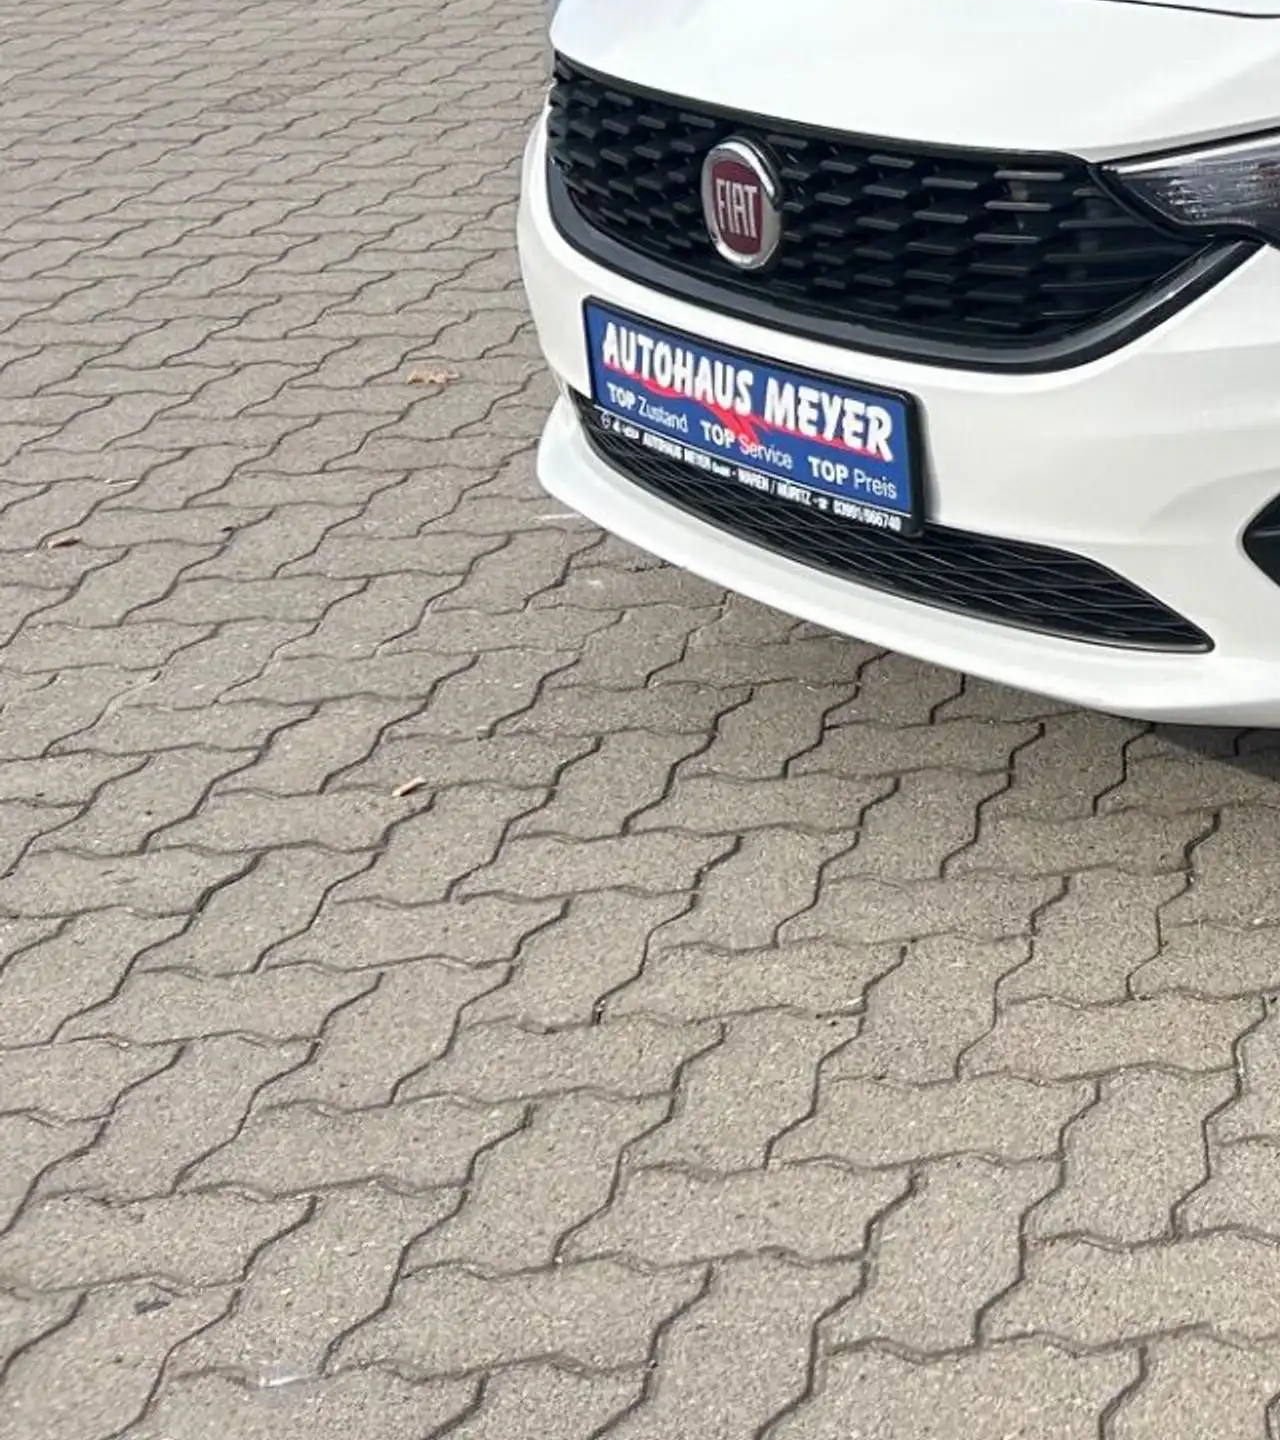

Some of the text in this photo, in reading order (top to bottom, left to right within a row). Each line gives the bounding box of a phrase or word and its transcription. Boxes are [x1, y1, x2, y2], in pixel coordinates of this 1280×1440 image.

[715, 178, 758, 239] FIAT
[602, 321, 894, 462] AUTOHAUS MEYER
[606, 381, 636, 410] TOP
[638, 395, 689, 434] Zustand
[700, 420, 736, 449] TOP
[738, 433, 794, 471] Service
[808, 456, 849, 486] TOP
[853, 468, 898, 501] Preis
